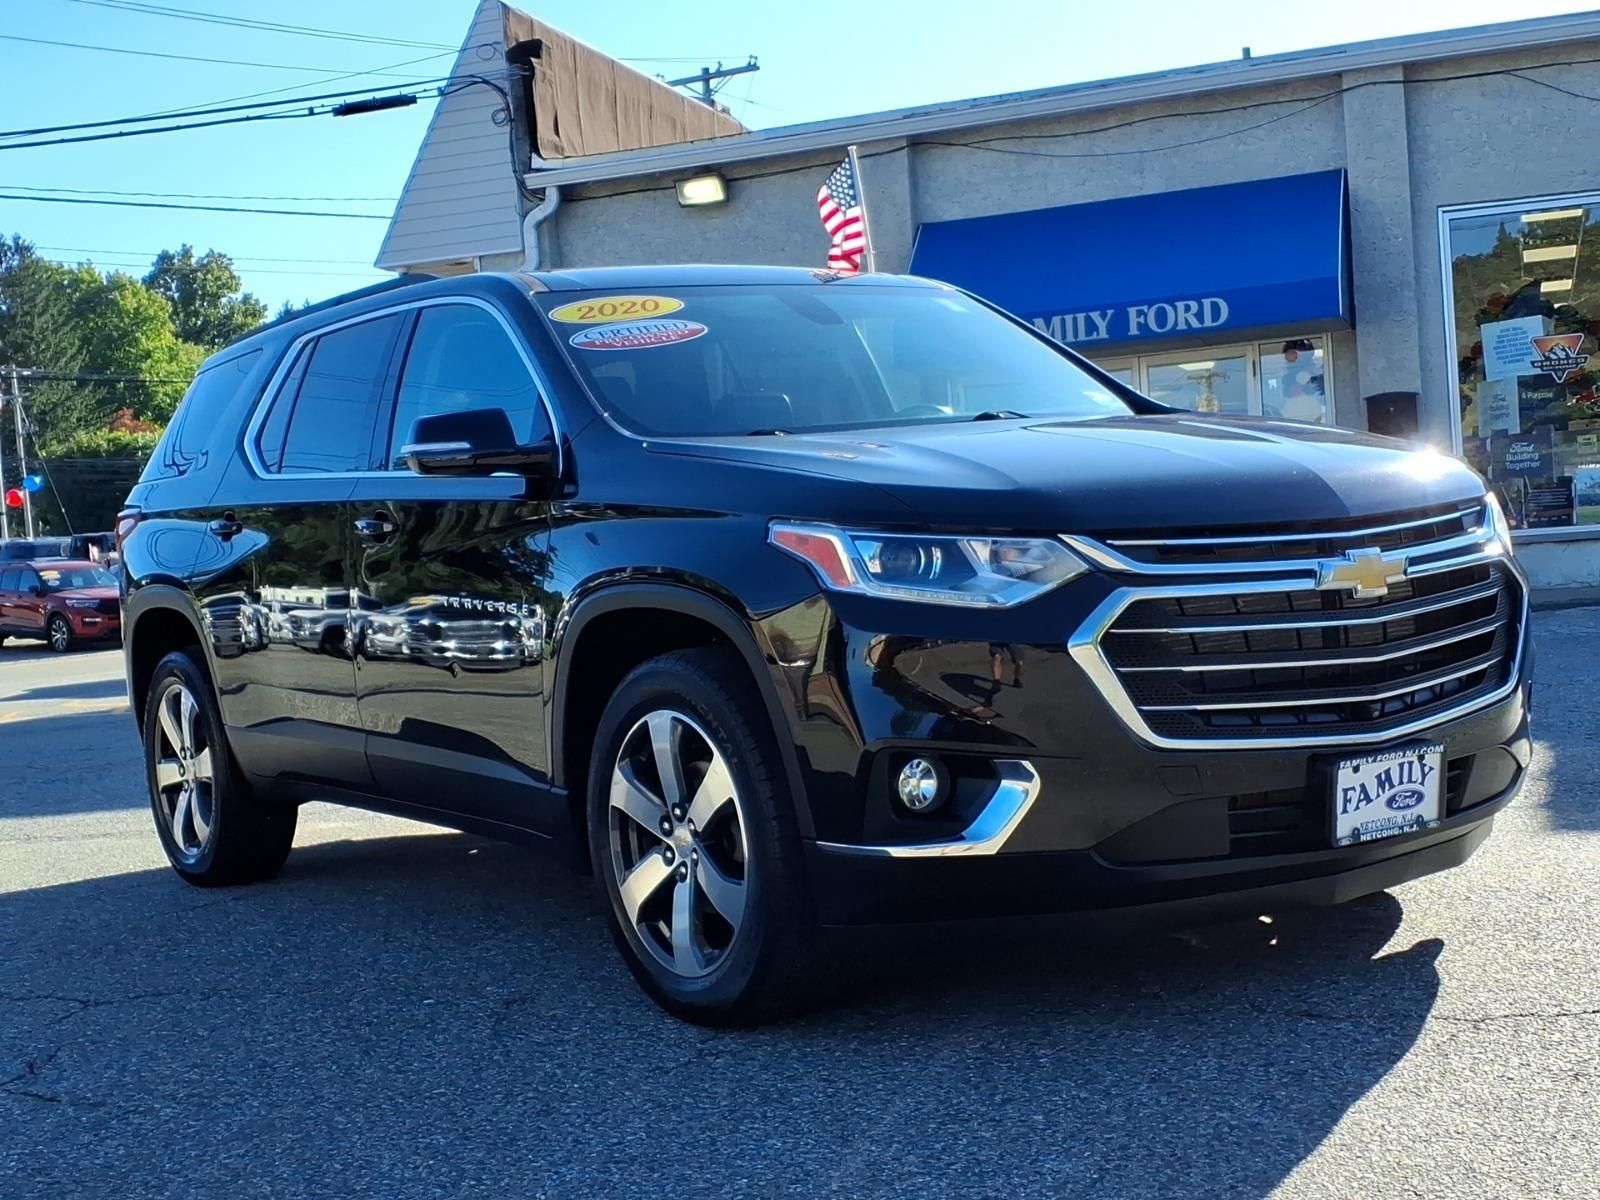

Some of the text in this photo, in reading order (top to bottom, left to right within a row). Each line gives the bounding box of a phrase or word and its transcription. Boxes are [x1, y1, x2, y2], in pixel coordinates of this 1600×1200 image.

[576, 299, 660, 321] 2020
[1126, 297, 1229, 336] FORD
[583, 321, 689, 340] CERTIFIED
[1534, 357, 1585, 367] BRONCO
[1506, 452, 1539, 461] Building
[1510, 442, 1534, 453] Ford
[1505, 460, 1541, 471] Together
[442, 596, 529, 616] TRAVERSE
[1340, 757, 1374, 769] FAMILY
[1376, 751, 1403, 762] FORD
[1340, 760, 1435, 815] FAMILY
[1392, 791, 1418, 809] Ford
[1360, 827, 1402, 842] NETCONG,
[1403, 823, 1420, 833] N.J.
